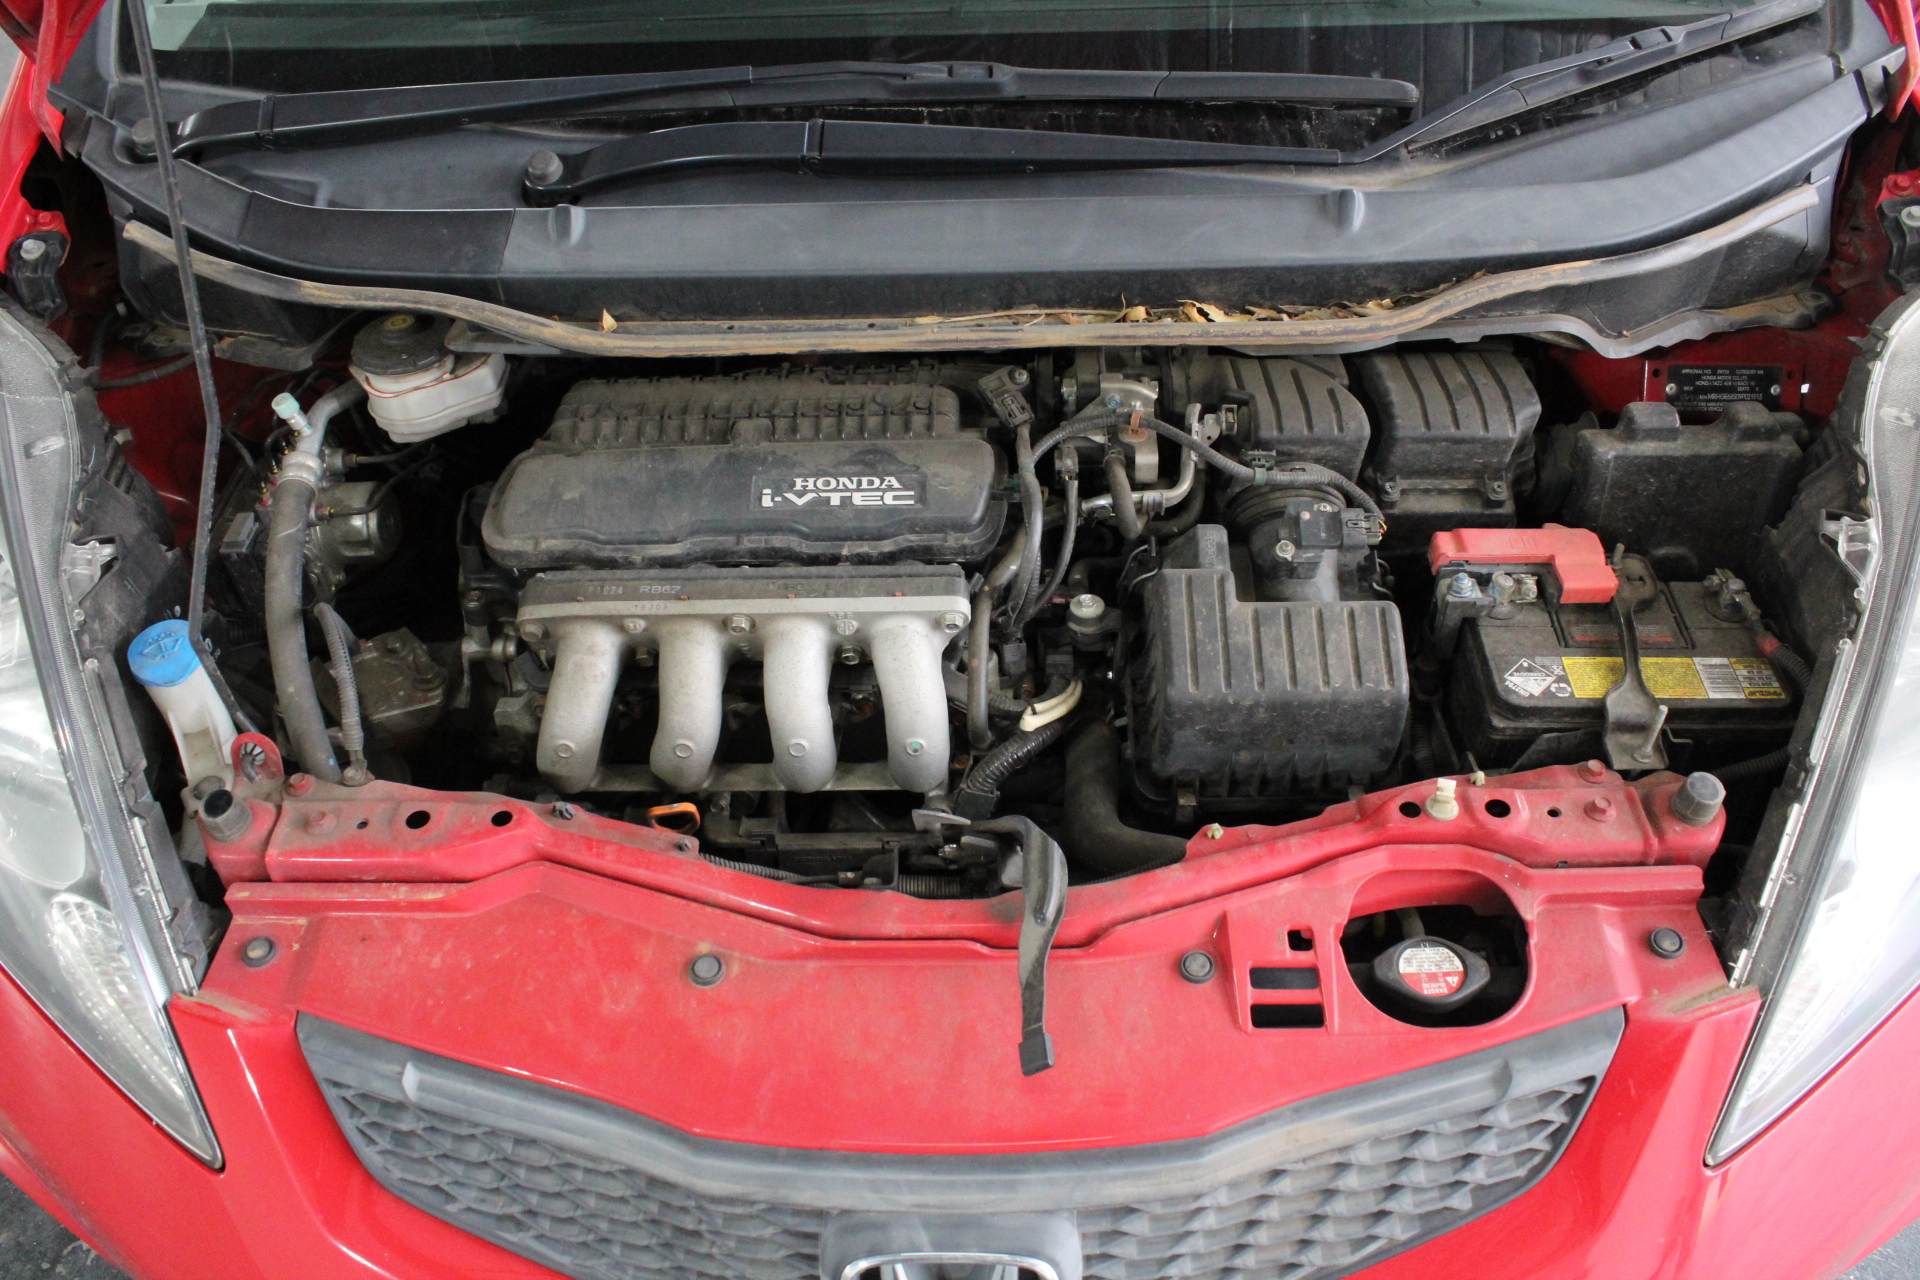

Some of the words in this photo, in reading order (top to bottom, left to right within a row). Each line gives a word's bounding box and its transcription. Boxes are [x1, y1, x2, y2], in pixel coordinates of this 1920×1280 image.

[793, 476, 903, 490] HONDA
[761, 488, 915, 508] i-VTEC
[1504, 680, 1530, 698] UN2794
